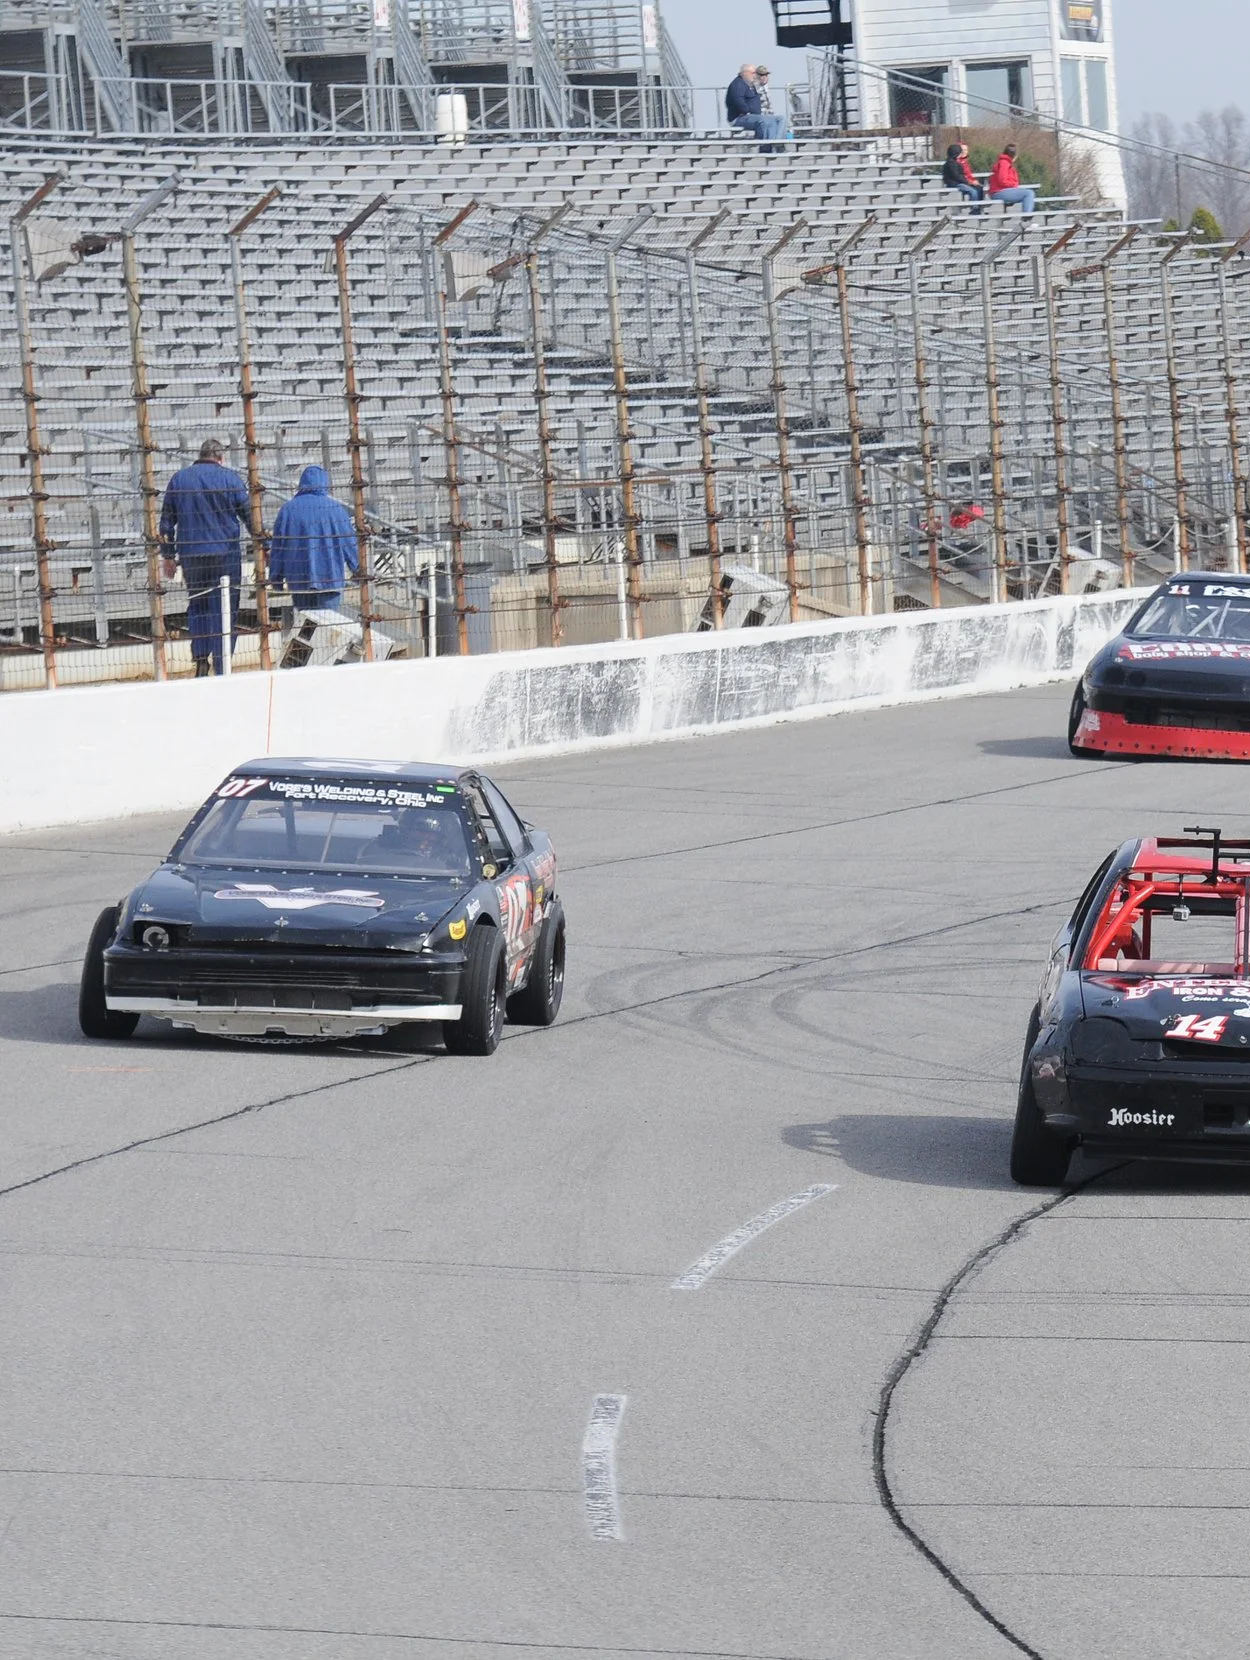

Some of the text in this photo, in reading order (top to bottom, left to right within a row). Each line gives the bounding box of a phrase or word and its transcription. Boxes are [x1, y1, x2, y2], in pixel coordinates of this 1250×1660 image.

[1168, 585, 1191, 595] 11
[218, 778, 267, 797] 07
[314, 784, 375, 797] WELDING
[375, 789, 387, 798] &
[387, 789, 425, 801] STEEL
[285, 791, 427, 808] Fort Recovery, Ohio
[1173, 987, 1223, 996] IRON
[1181, 994, 1219, 1003] Come
[1165, 1014, 1229, 1041] 14
[1107, 1107, 1175, 1126] Hoosier
